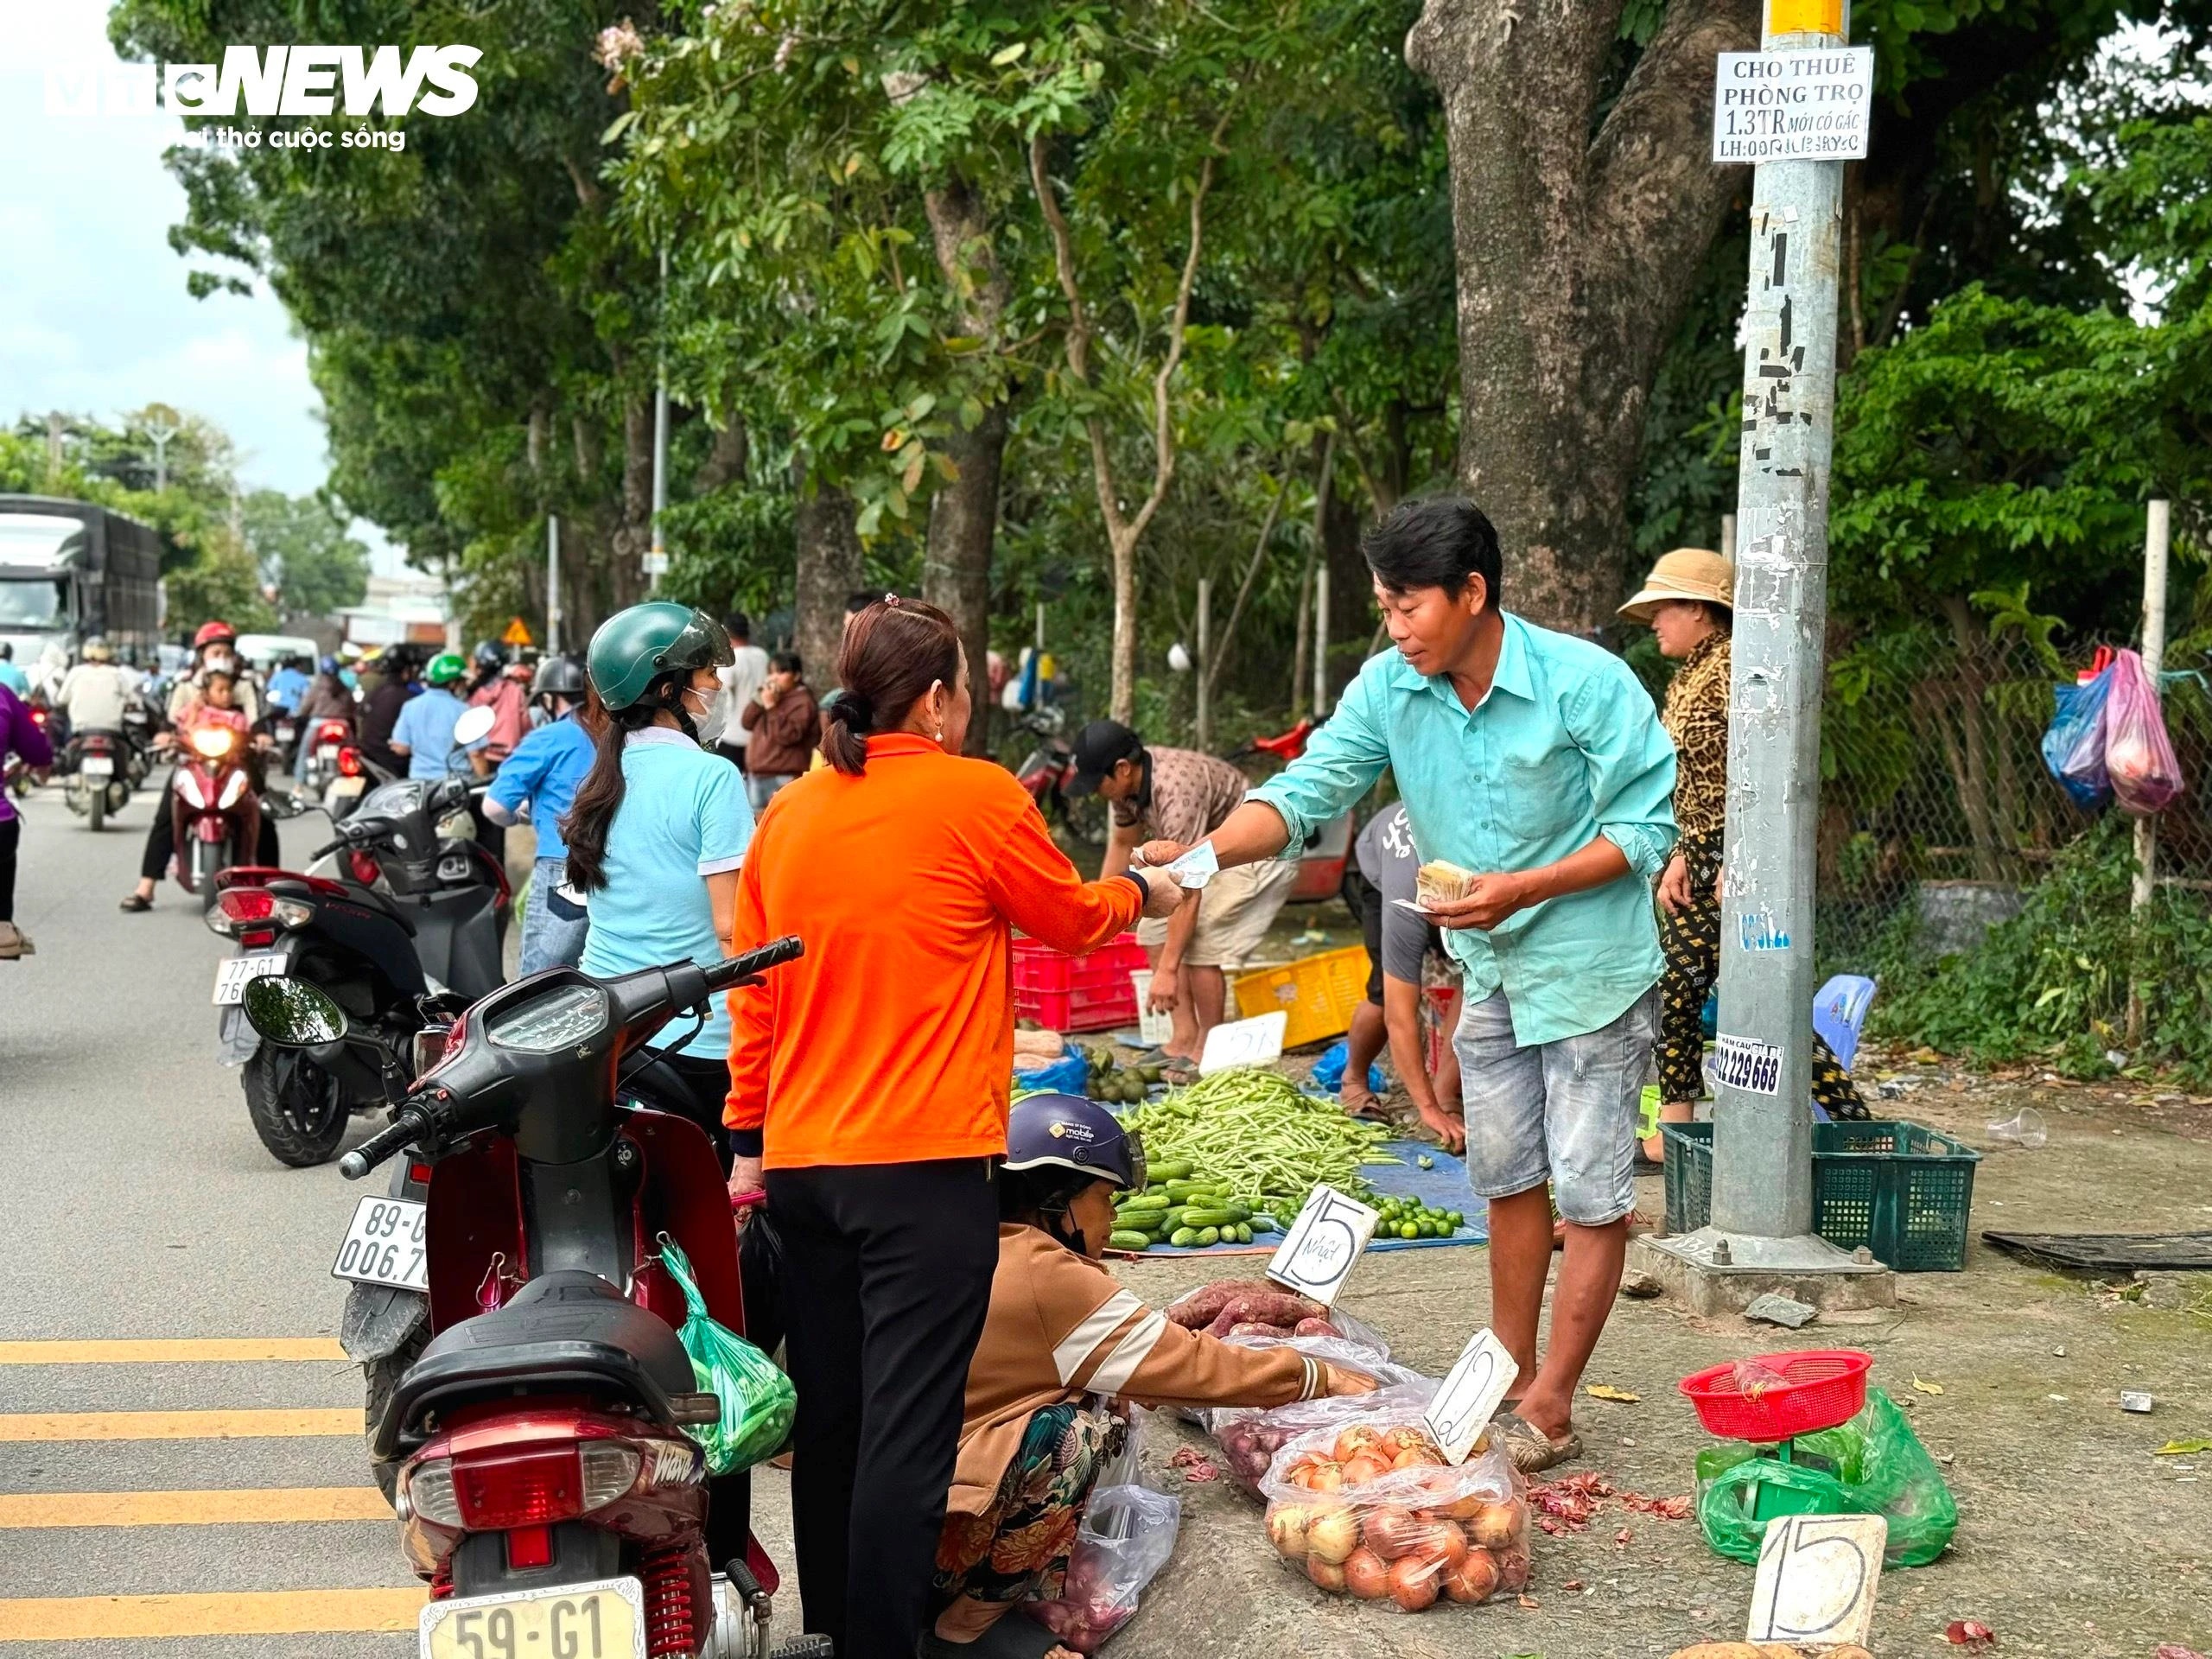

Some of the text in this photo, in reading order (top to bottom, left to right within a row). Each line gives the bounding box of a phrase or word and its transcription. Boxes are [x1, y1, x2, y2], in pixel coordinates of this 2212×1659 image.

[1733, 53, 1856, 79] CHO THUÊ
[1724, 83, 1864, 105] PHÒNG TRỌ
[1726, 109, 1785, 135] 1.3TR
[1747, 1517, 1867, 1642] 15
[455, 1595, 603, 1658] 59-G1
